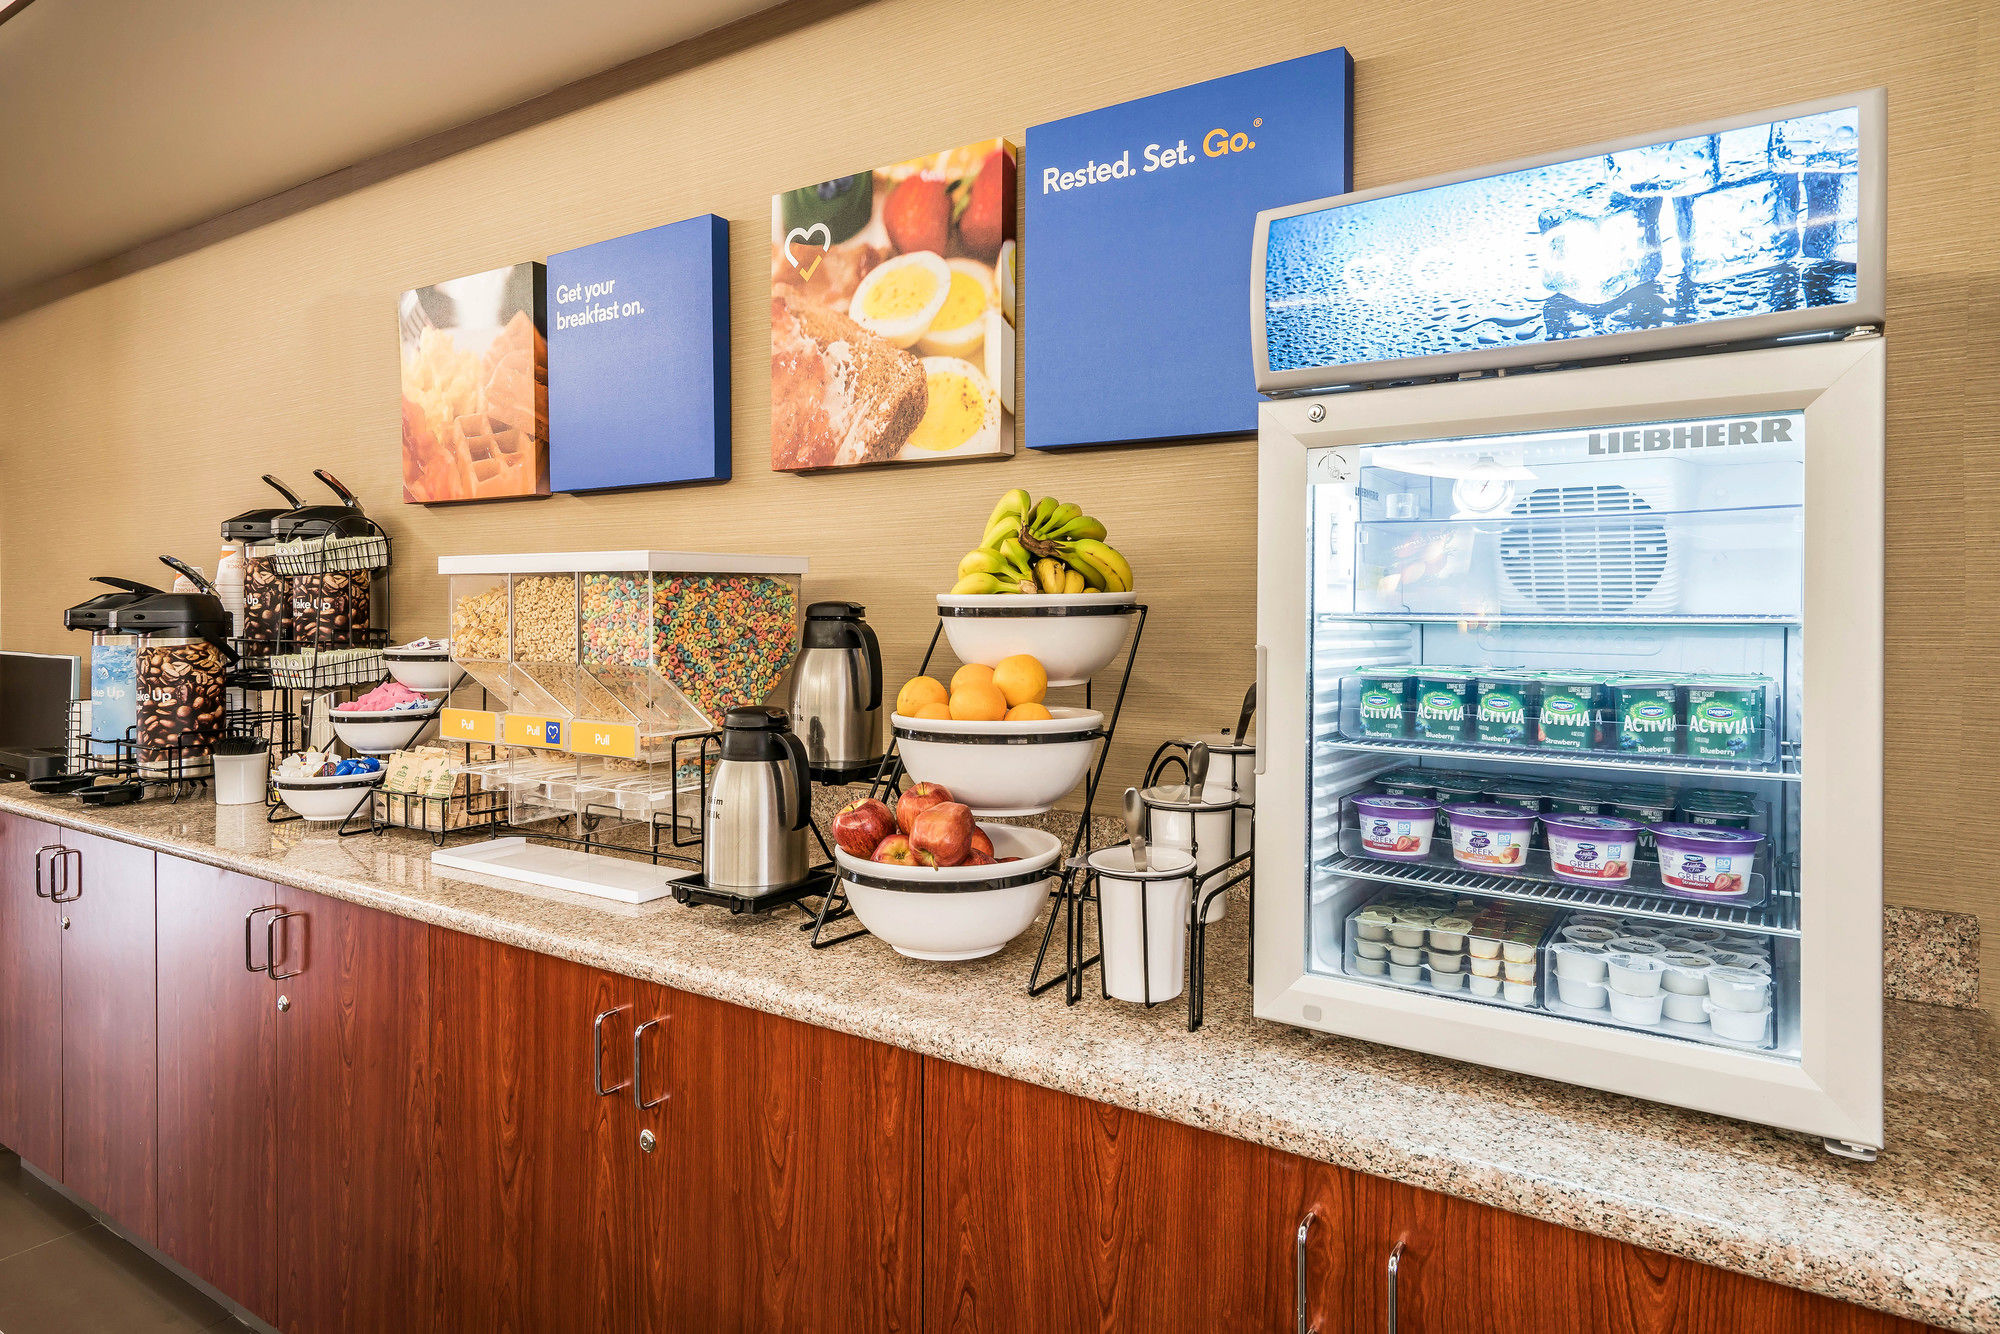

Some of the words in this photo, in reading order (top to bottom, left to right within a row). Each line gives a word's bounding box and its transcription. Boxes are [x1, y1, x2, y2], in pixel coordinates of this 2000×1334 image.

[1043, 150, 1137, 195] Rested.
[1143, 140, 1196, 172] Set.
[556, 282, 582, 304] Get
[584, 280, 615, 303] your
[556, 301, 619, 330] breakfast
[622, 301, 645, 317] on.
[1588, 418, 1793, 455] LIEBHERR
[247, 594, 259, 605] Up
[313, 599, 331, 612] Up
[107, 686, 125, 700] Up
[153, 690, 172, 703] Up
[1360, 702, 1403, 719] ACTIVIA
[1417, 702, 1464, 721] ACTIVIA
[1476, 705, 1525, 724] ACTIVIA
[1540, 707, 1591, 727] ACTIVIA
[461, 719, 475, 731] Pull
[1623, 714, 1678, 733] ACTIVIA
[1689, 715, 1748, 734] ACTIVIA
[526, 725, 540, 736] Pull
[1365, 730, 1393, 738] Blueberry
[1425, 732, 1455, 741] Blueberry
[595, 733, 610, 746] Pull
[1481, 734, 1511, 744] Blueberry
[1545, 737, 1580, 747] Strawberry
[1637, 745, 1671, 754] Blueberry
[1700, 746, 1736, 757] Blueberry
[1370, 835, 1395, 844] GREEK
[1466, 846, 1494, 856] GREEK
[1608, 846, 1620, 854] 80
[1569, 860, 1601, 869] GREEK
[1677, 871, 1712, 883] GREEK
[1681, 879, 1709, 888] Strawberry
